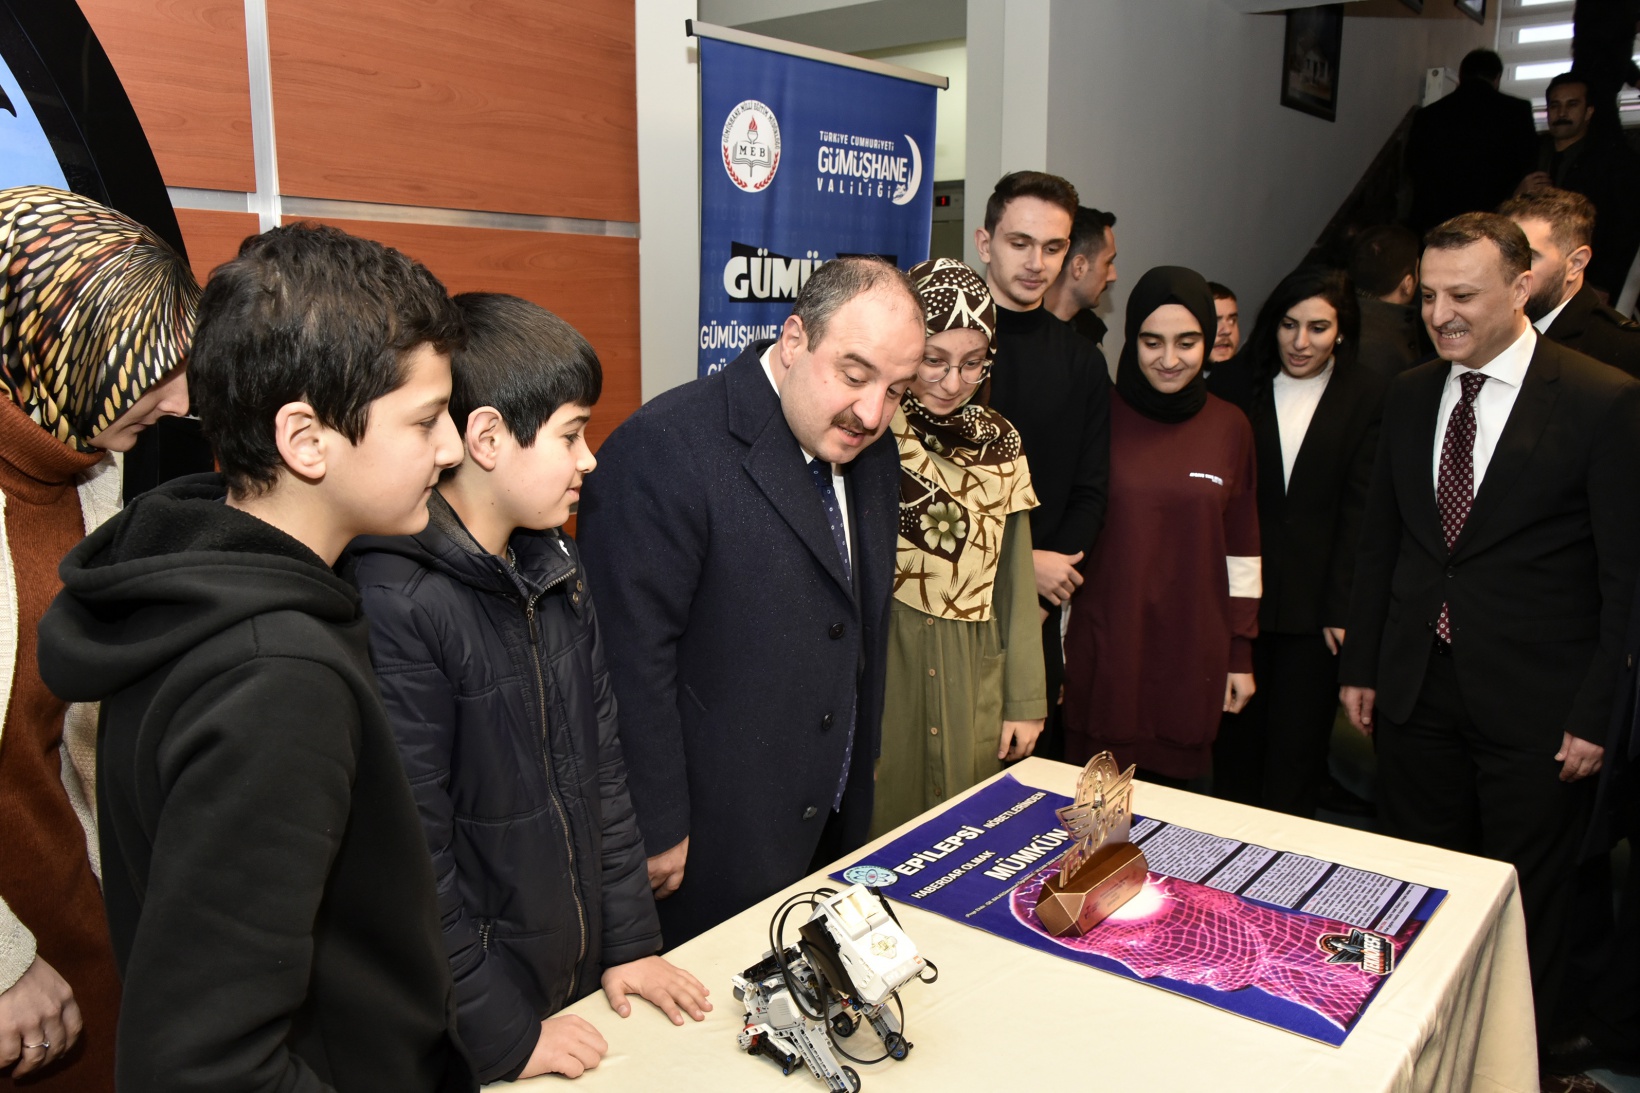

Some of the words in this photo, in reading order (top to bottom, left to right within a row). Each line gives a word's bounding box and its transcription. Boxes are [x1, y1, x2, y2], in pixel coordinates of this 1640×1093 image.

[739, 145, 766, 158] MEB
[817, 145, 908, 183] GÜMÜŞHANE
[893, 824, 985, 876] EPİLEPSİ
[983, 791, 1047, 829] NÖBETLERİNDEN
[983, 828, 1069, 881] MÜMKÜN
[910, 866, 964, 899] HABERDAR
[959, 850, 996, 873] OLMAK
